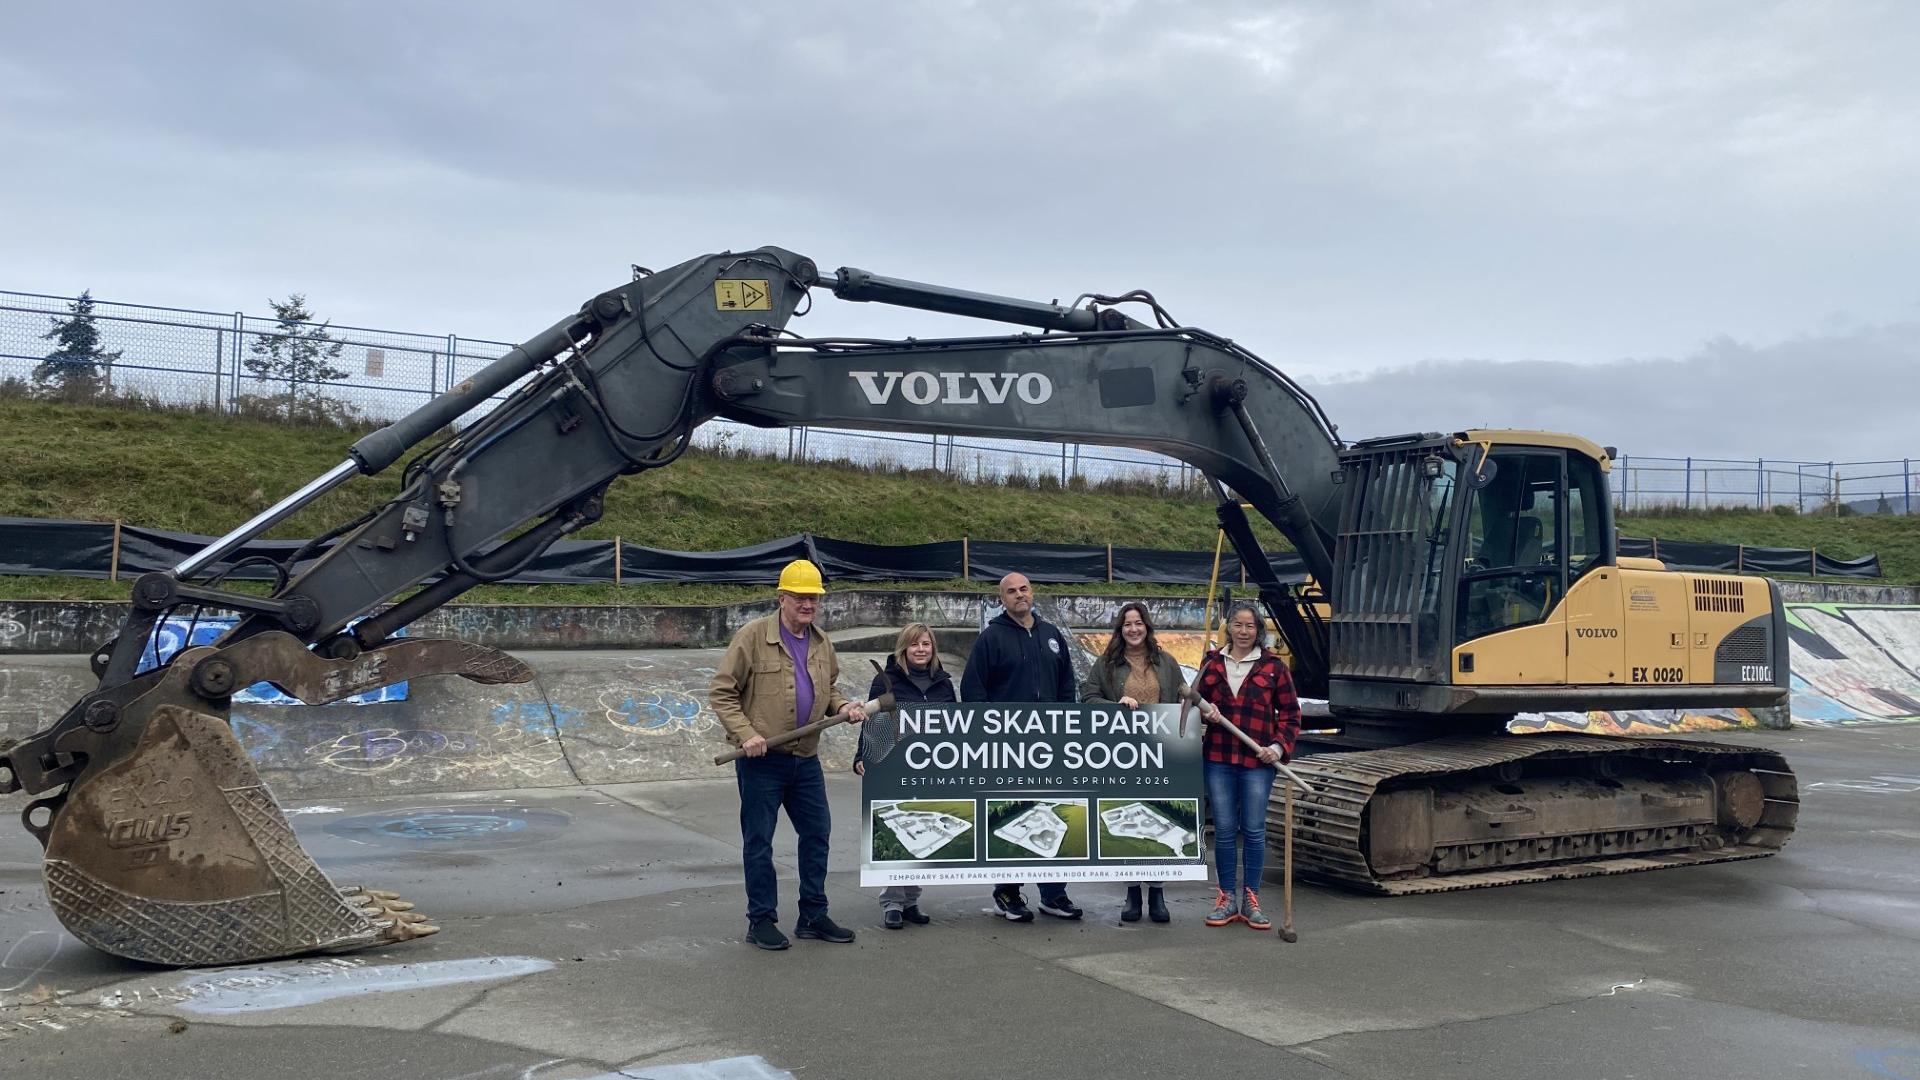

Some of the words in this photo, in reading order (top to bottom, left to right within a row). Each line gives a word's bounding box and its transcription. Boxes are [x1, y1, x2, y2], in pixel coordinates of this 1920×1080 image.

[849, 371, 1053, 405] VOLVO
[1575, 628, 1618, 638] VOLVO
[1632, 667, 1648, 682] EX
[1653, 667, 1684, 683] 0020
[899, 709, 975, 734] NEW
[983, 709, 1082, 735] SKATE
[1091, 710, 1171, 735] PARK
[905, 741, 1054, 770] COMING
[1063, 741, 1164, 770] SOON
[901, 777, 986, 786] ESTIMATED
[996, 776, 1063, 785] OPENING
[1072, 776, 1127, 785] SPRING
[1136, 776, 1170, 785] 2026
